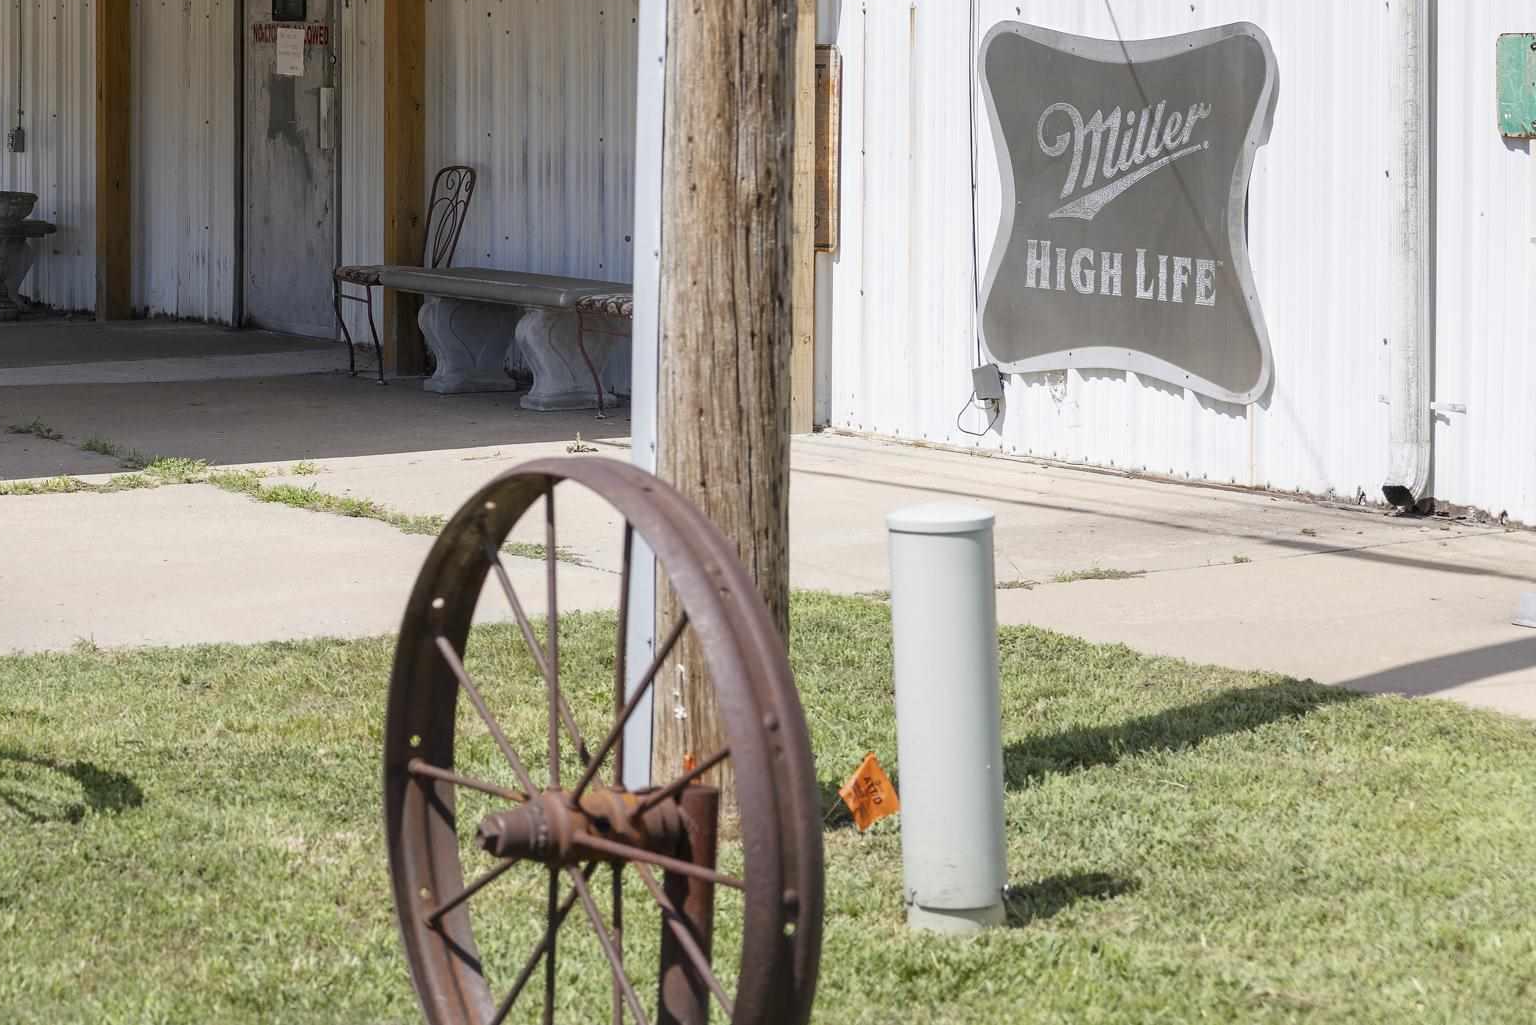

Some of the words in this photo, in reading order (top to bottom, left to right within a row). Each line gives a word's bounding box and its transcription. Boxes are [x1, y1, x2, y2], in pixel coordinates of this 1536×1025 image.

[1037, 99, 1213, 200] Miller
[1024, 239, 1124, 296] HIGH
[1135, 248, 1219, 307] LIFE
